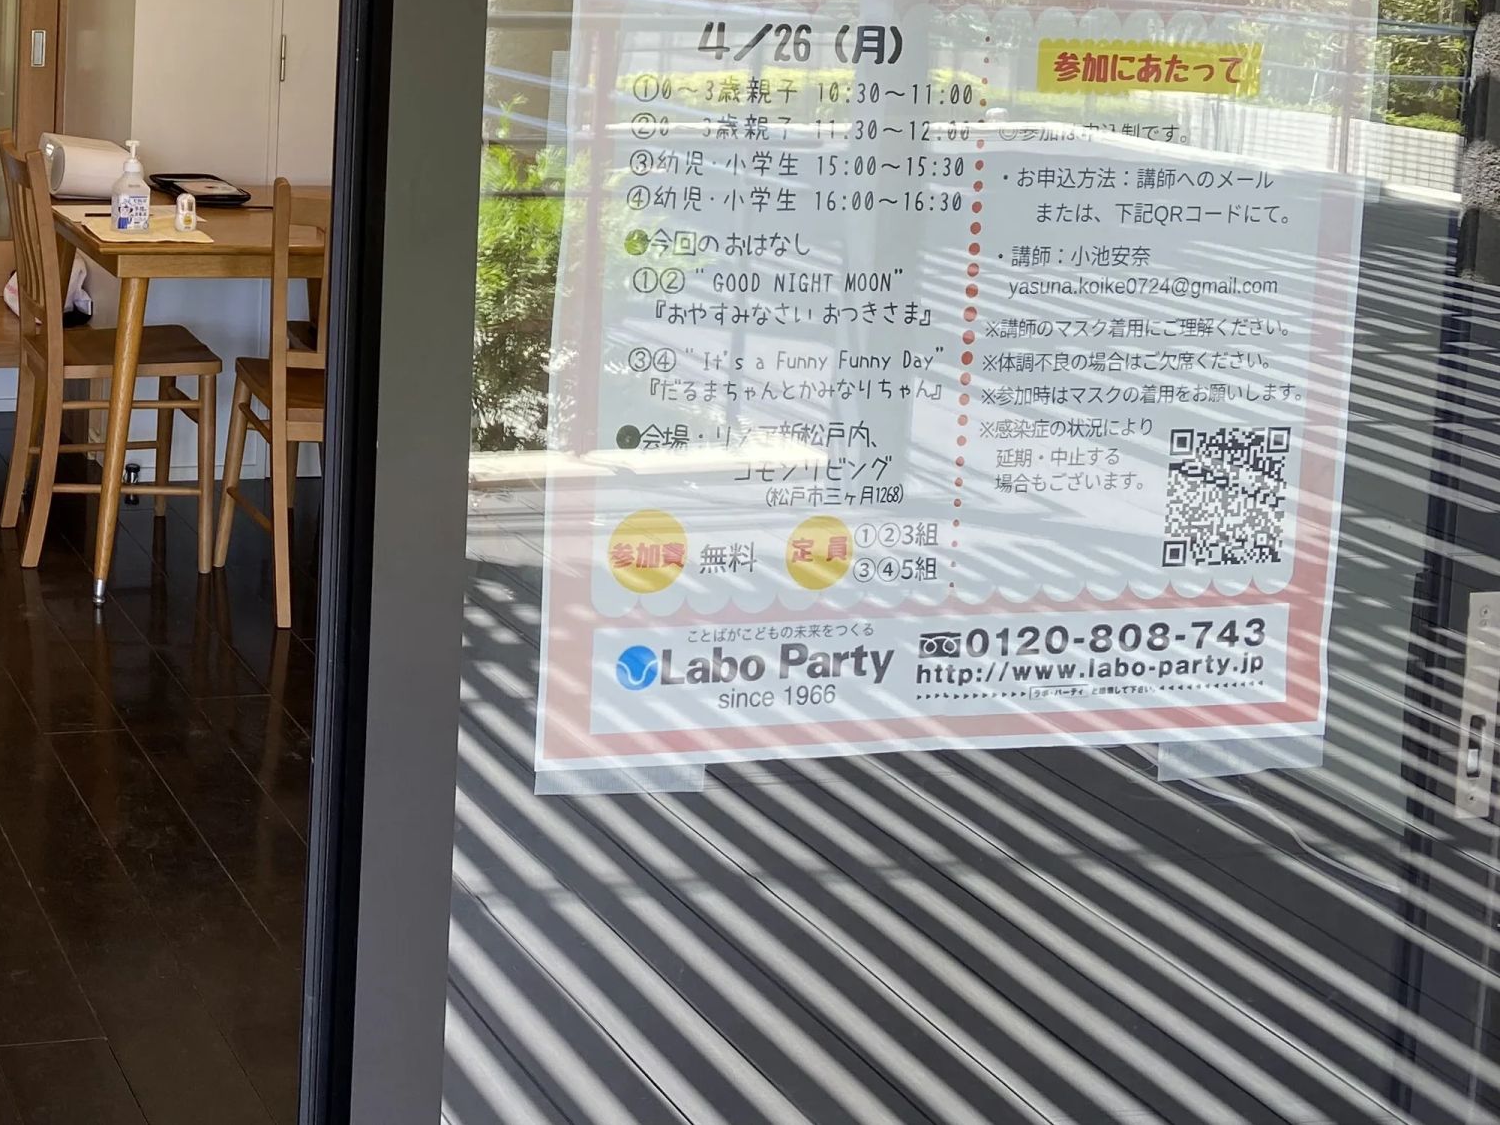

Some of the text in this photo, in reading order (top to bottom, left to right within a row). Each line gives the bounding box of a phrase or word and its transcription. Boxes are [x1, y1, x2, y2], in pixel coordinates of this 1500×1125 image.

[1053, 52, 1244, 84] 参加にあたって
[773, 274, 834, 293] NIGHT
[1008, 276, 1279, 299] yasuna.koike0724@gmail.com
[755, 357, 765, 371] a
[776, 352, 828, 375] Funny
[838, 351, 891, 375] Funny
[995, 473, 1145, 493] 場合もございます。
[611, 542, 686, 569] 参加費
[699, 542, 757, 574] 無料
[688, 623, 874, 644] ことばがこどもの未来をつくる
[966, 617, 1266, 657] 0120-808-743
[660, 642, 895, 685] Labo Party
[916, 653, 1265, 686] http://www.labo-party.jp
[718, 684, 836, 709] since 1966
